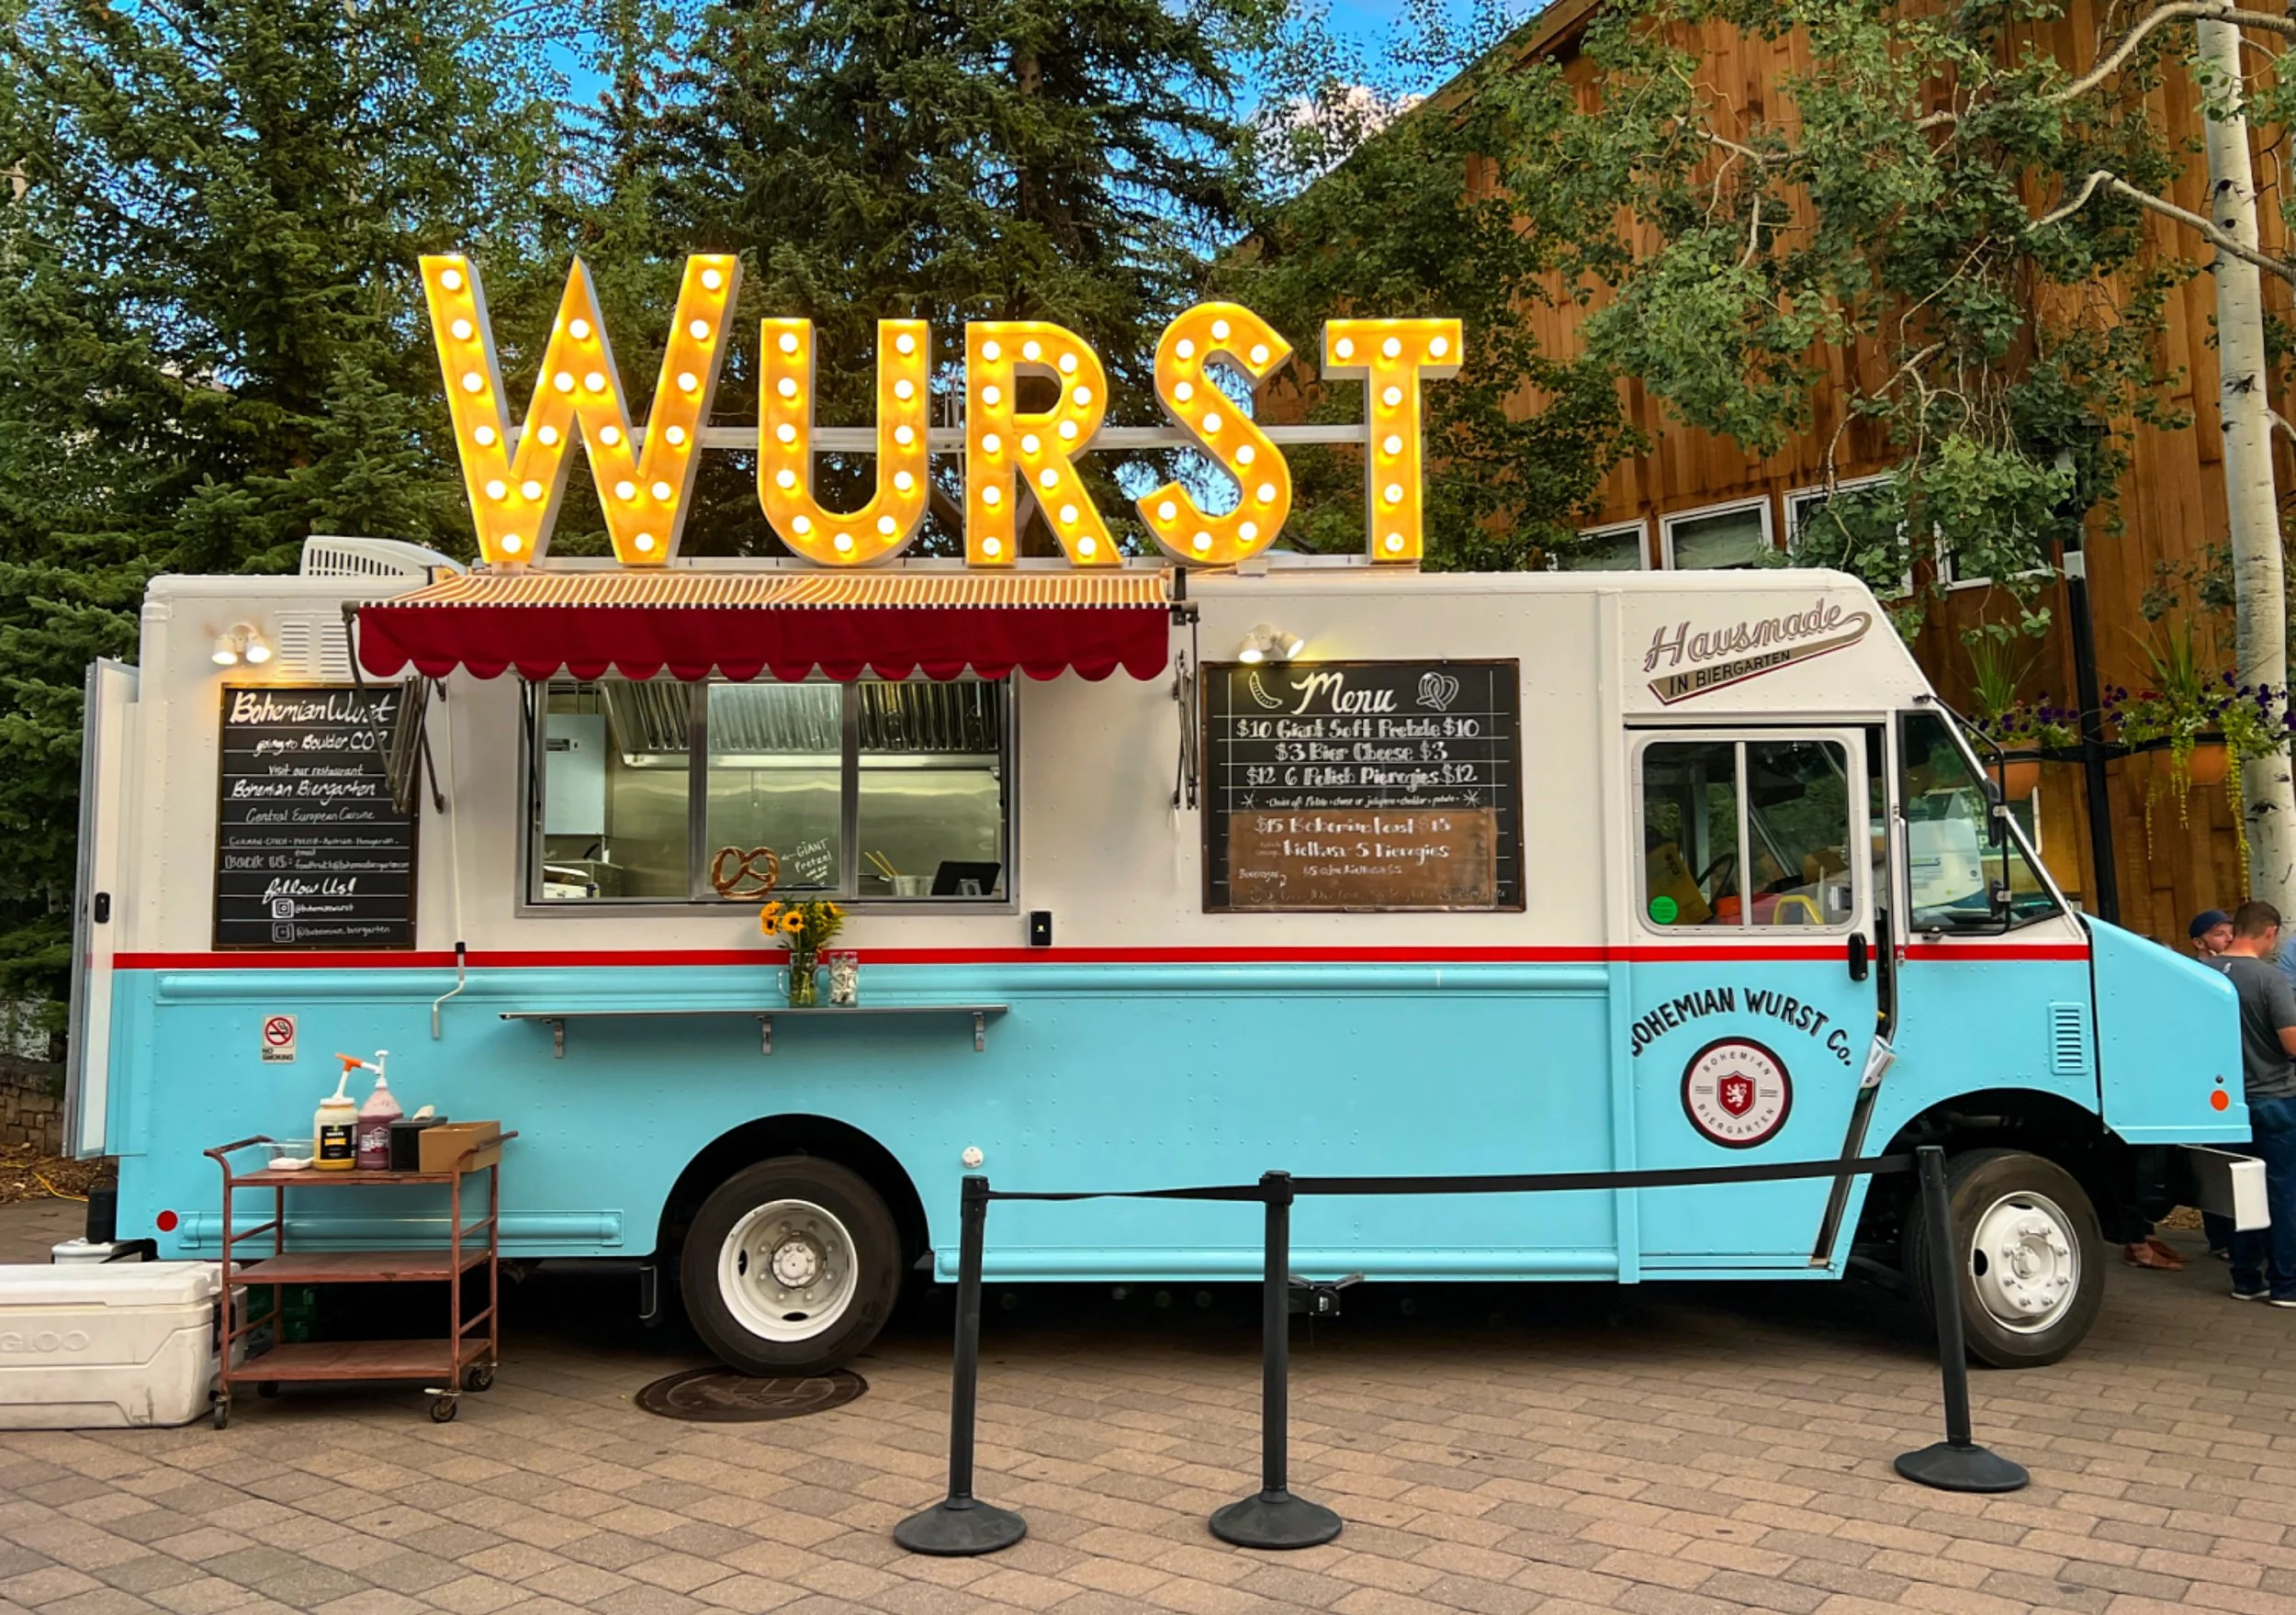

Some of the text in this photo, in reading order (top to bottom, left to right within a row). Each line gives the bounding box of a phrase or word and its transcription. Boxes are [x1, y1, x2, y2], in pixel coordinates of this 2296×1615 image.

[419, 252, 1464, 568] WURST
[1642, 598, 1841, 673] Hausmade
[1670, 649, 1791, 696] IN BIERGARTEN
[1290, 671, 1398, 715] Menu
[229, 691, 326, 724] Bohemian
[1236, 718, 1272, 738] $10
[1276, 718, 1325, 739] Giant
[1328, 718, 1372, 738] Soft
[1442, 716, 1480, 737] $10
[1275, 740, 1448, 762] $3 Bier Cheese $3
[293, 767, 310, 776] our
[1245, 765, 1277, 786] $12
[1285, 767, 1298, 786] 6
[1302, 766, 1356, 786] Polish
[1439, 763, 1480, 785] $12
[231, 779, 293, 799] Bohemian
[246, 807, 288, 824] Central
[292, 807, 338, 824] European
[793, 849, 833, 873] Pretzel
[1743, 987, 1829, 1037] WURST
[1826, 1028, 1851, 1066] Co.
[1703, 1050, 1772, 1076] BOHEMIAN
[1697, 1103, 1775, 1135] BIERGARTEN
